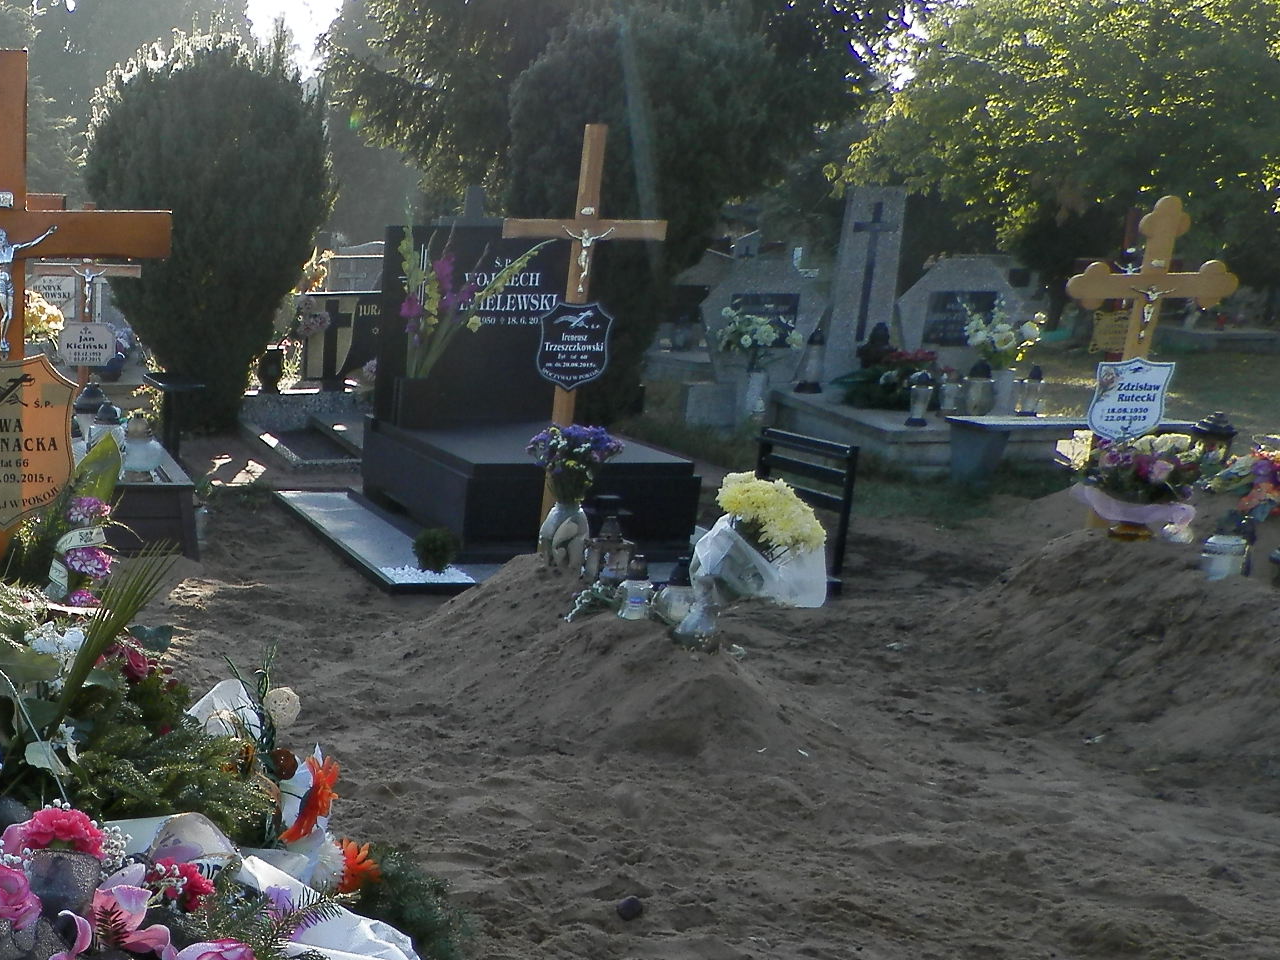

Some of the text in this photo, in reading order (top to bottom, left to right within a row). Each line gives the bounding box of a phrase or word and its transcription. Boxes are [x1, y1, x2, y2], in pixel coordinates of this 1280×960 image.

[79, 335, 95, 343] Jan
[561, 332, 589, 342] Ireneusz
[1116, 393, 1156, 402] Rutecki
[0, 459, 13, 468] lat
[15, 458, 29, 468] 66
